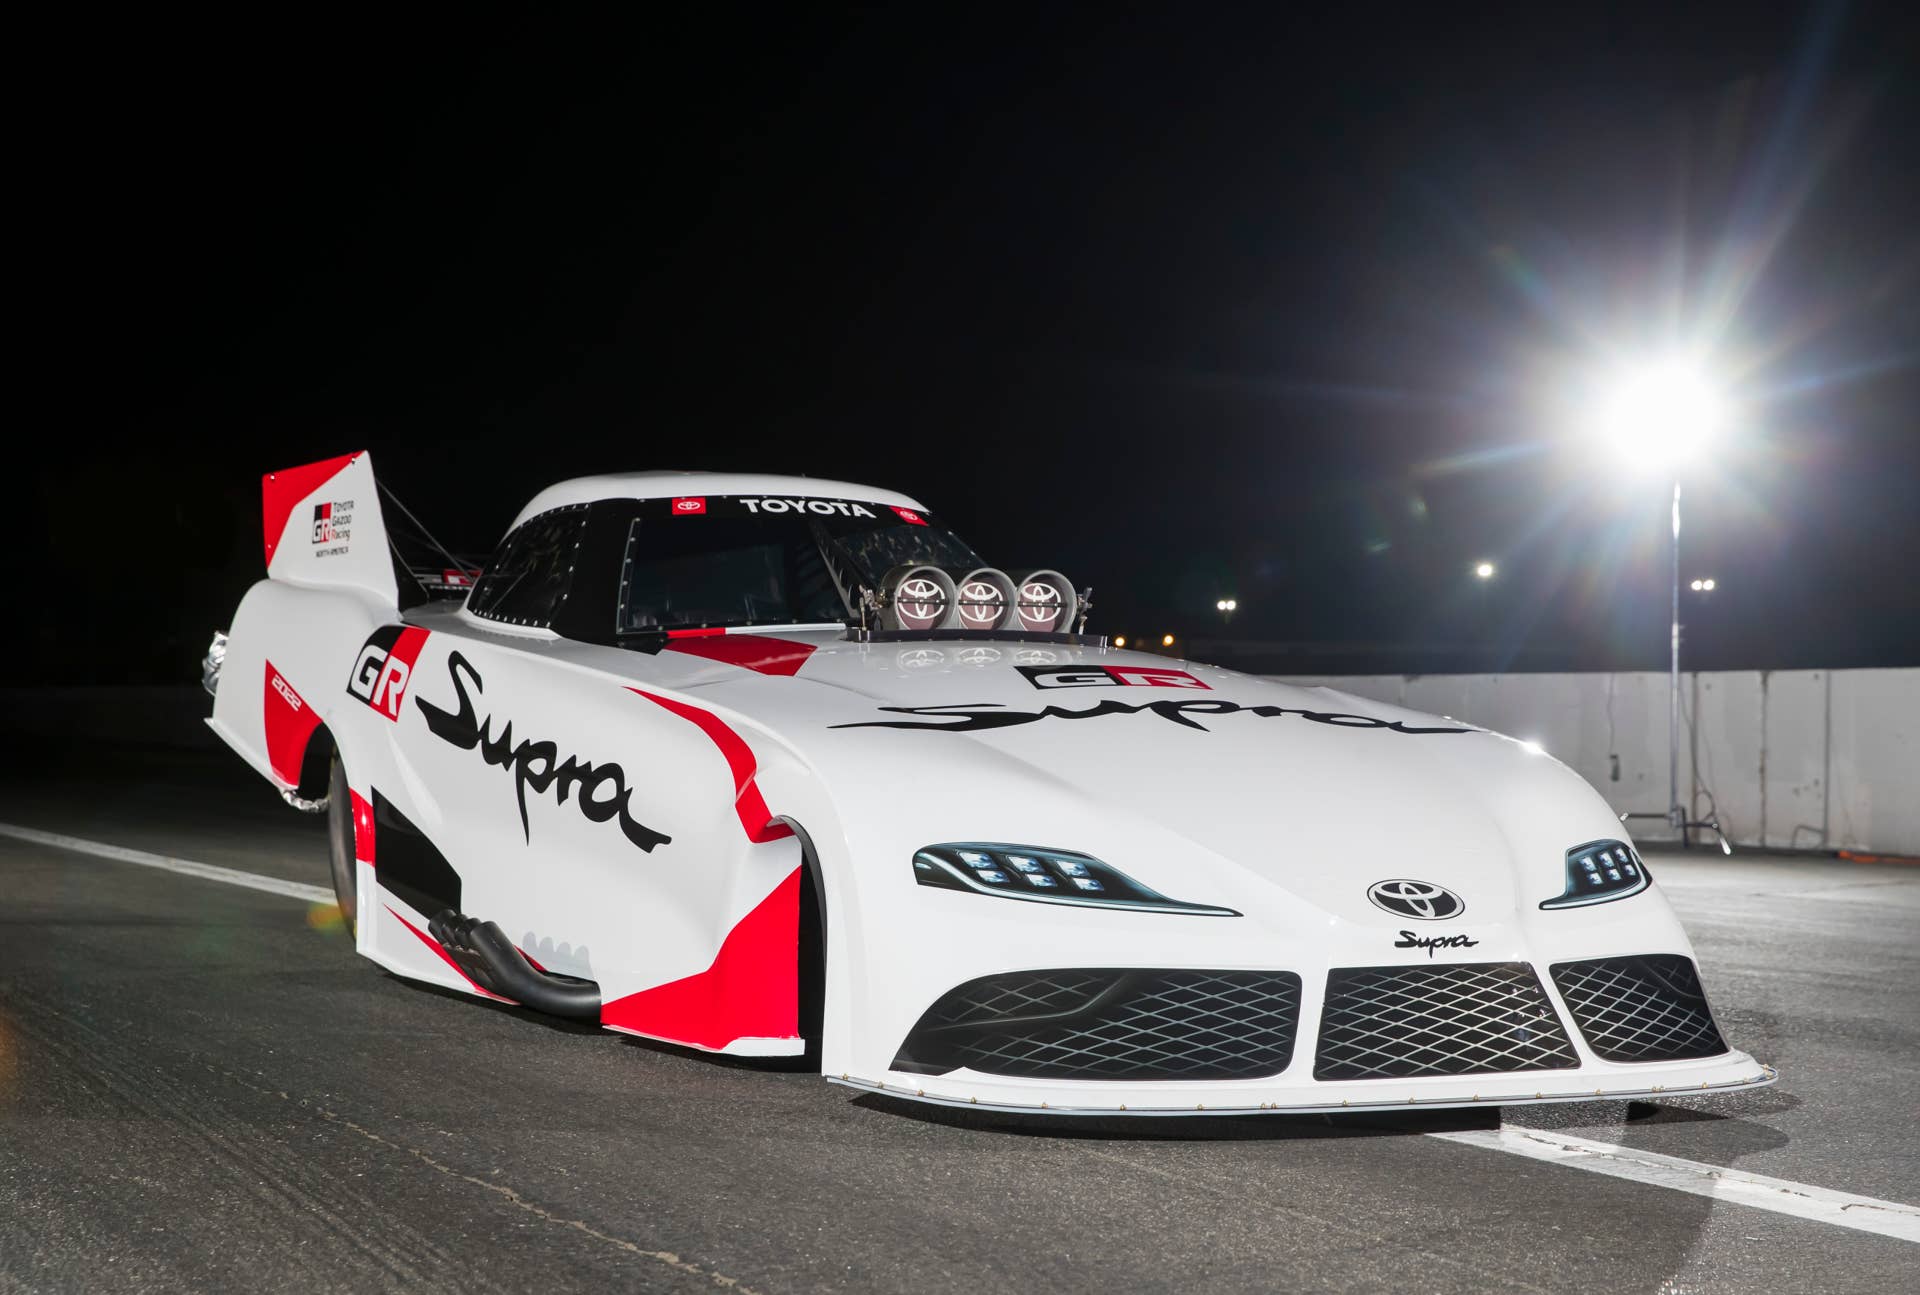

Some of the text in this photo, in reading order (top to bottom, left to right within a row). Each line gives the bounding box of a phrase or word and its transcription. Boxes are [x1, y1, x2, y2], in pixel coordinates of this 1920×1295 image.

[333, 500, 354, 512] TOYOTA
[740, 499, 877, 518] TOYOTA
[313, 520, 330, 542] GR
[331, 528, 351, 541] Racing
[272, 674, 302, 711] 2022
[350, 645, 409, 717] GR
[1034, 672, 1206, 688] GR
[827, 699, 1477, 733] Supra
[415, 650, 672, 853] Supra
[1394, 930, 1479, 959] Supra
